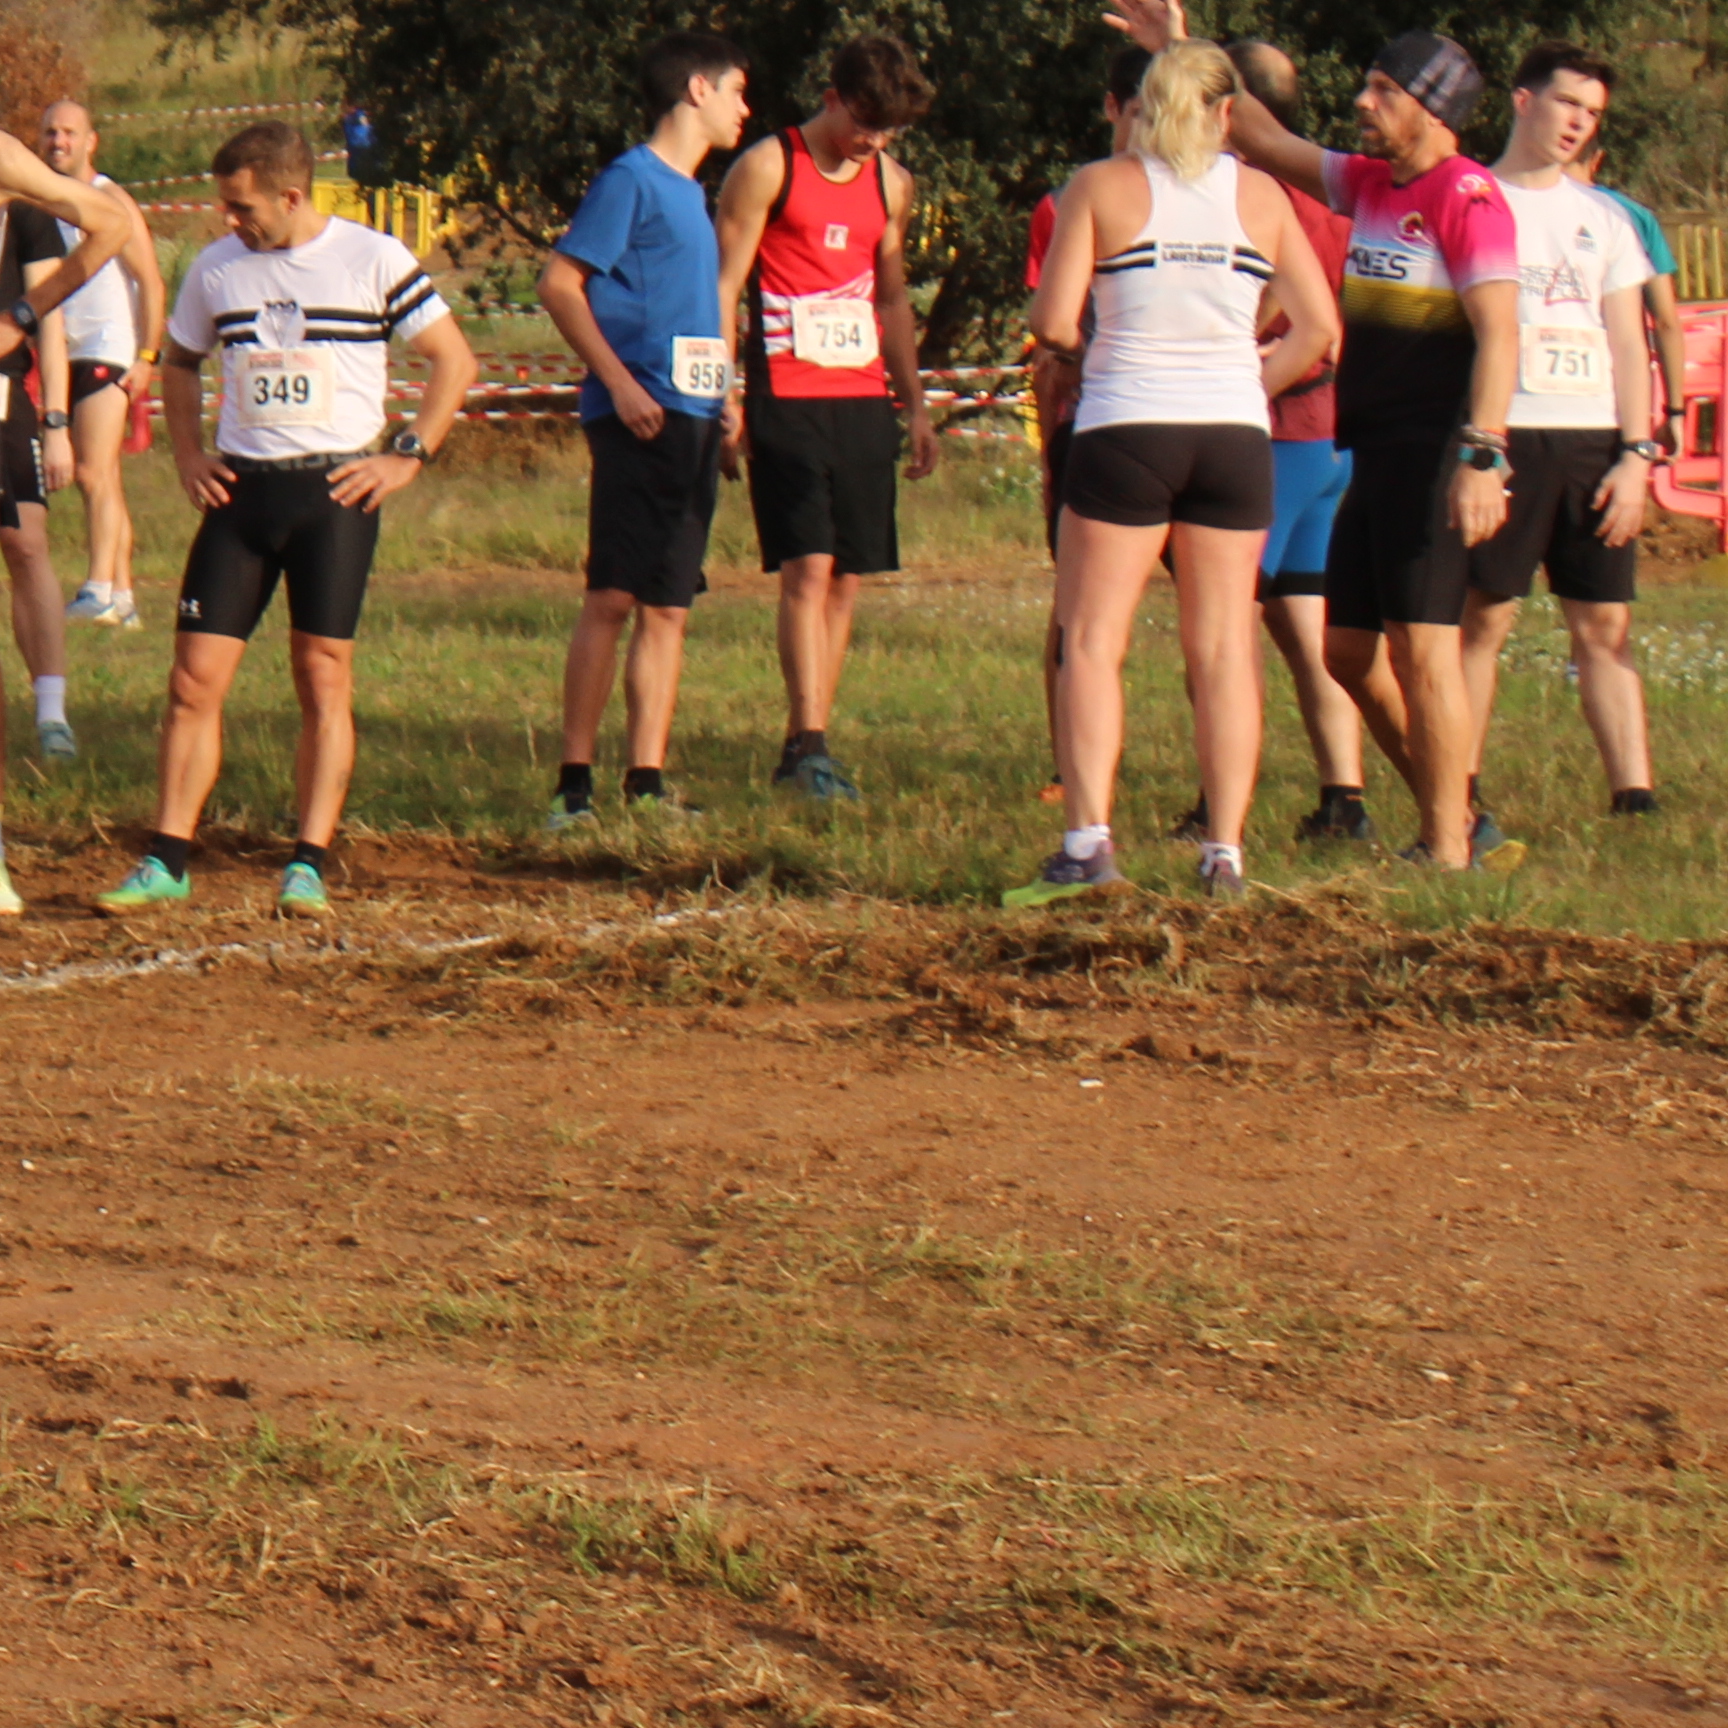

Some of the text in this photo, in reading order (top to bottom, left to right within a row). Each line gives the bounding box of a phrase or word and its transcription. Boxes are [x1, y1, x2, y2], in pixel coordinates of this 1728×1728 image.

[816, 323, 863, 349] 754
[689, 362, 727, 390] 958
[1546, 348, 1591, 378] 751
[254, 374, 310, 406] 349
